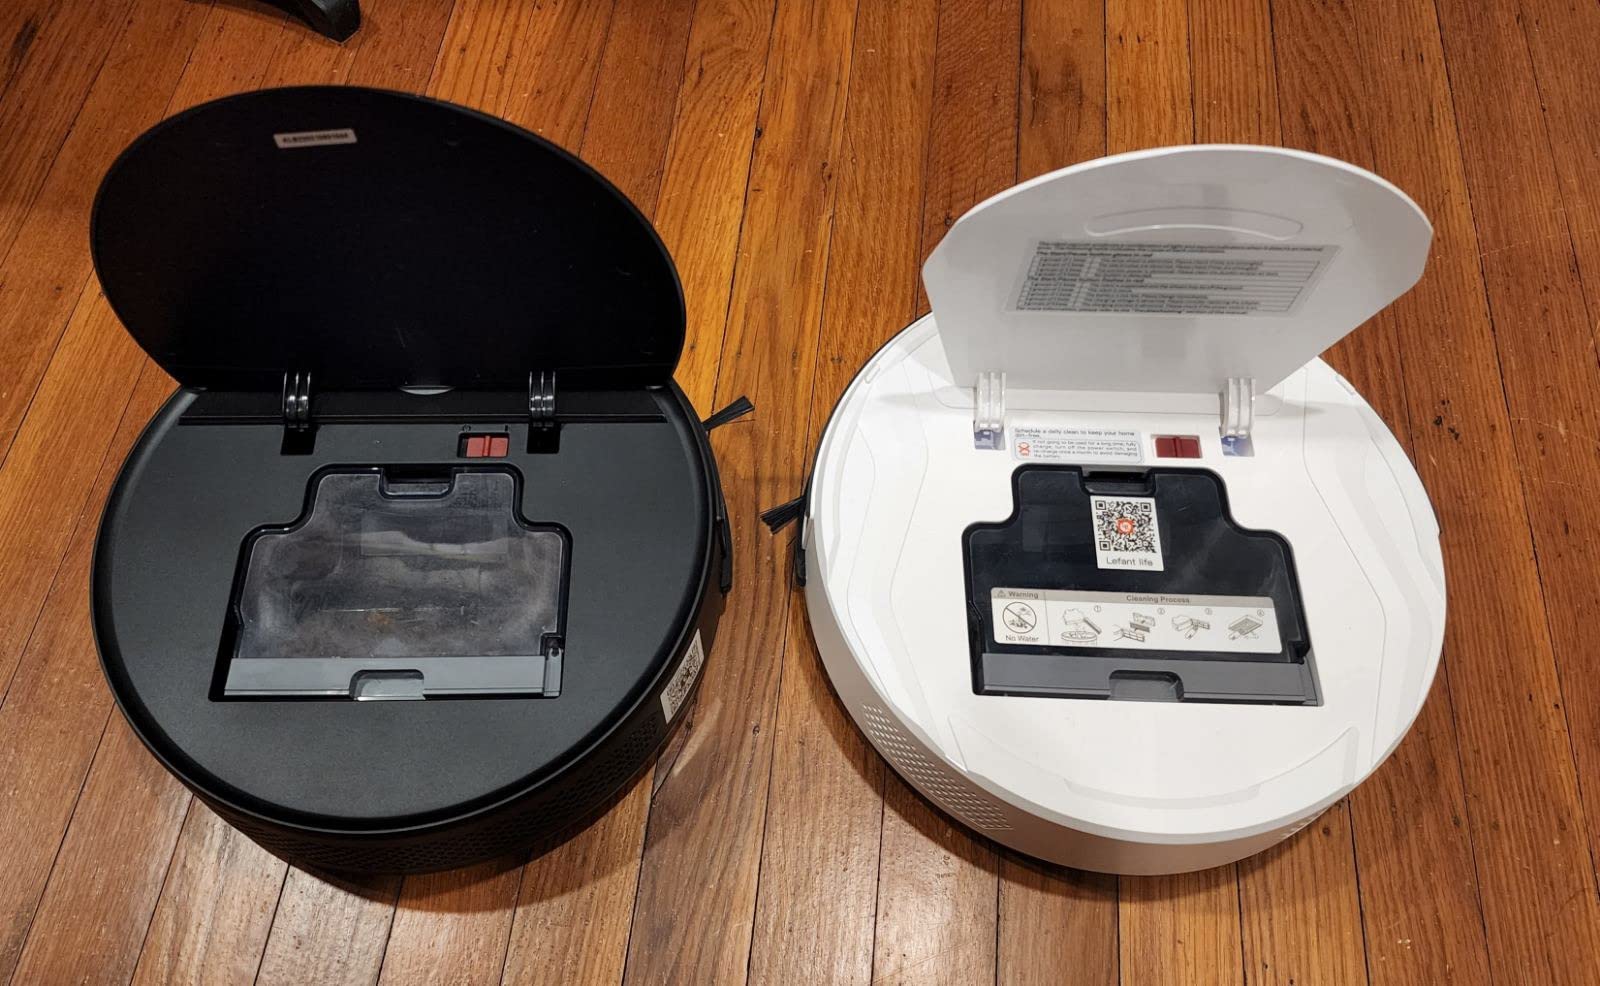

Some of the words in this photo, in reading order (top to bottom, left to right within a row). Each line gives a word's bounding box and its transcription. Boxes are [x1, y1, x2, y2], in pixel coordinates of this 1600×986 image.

[1107, 557, 1136, 566] Lefant
[1139, 557, 1153, 567] life
[1008, 591, 1039, 600] Warning
[1126, 594, 1159, 603] Cleaning
[1160, 595, 1190, 603] Process
